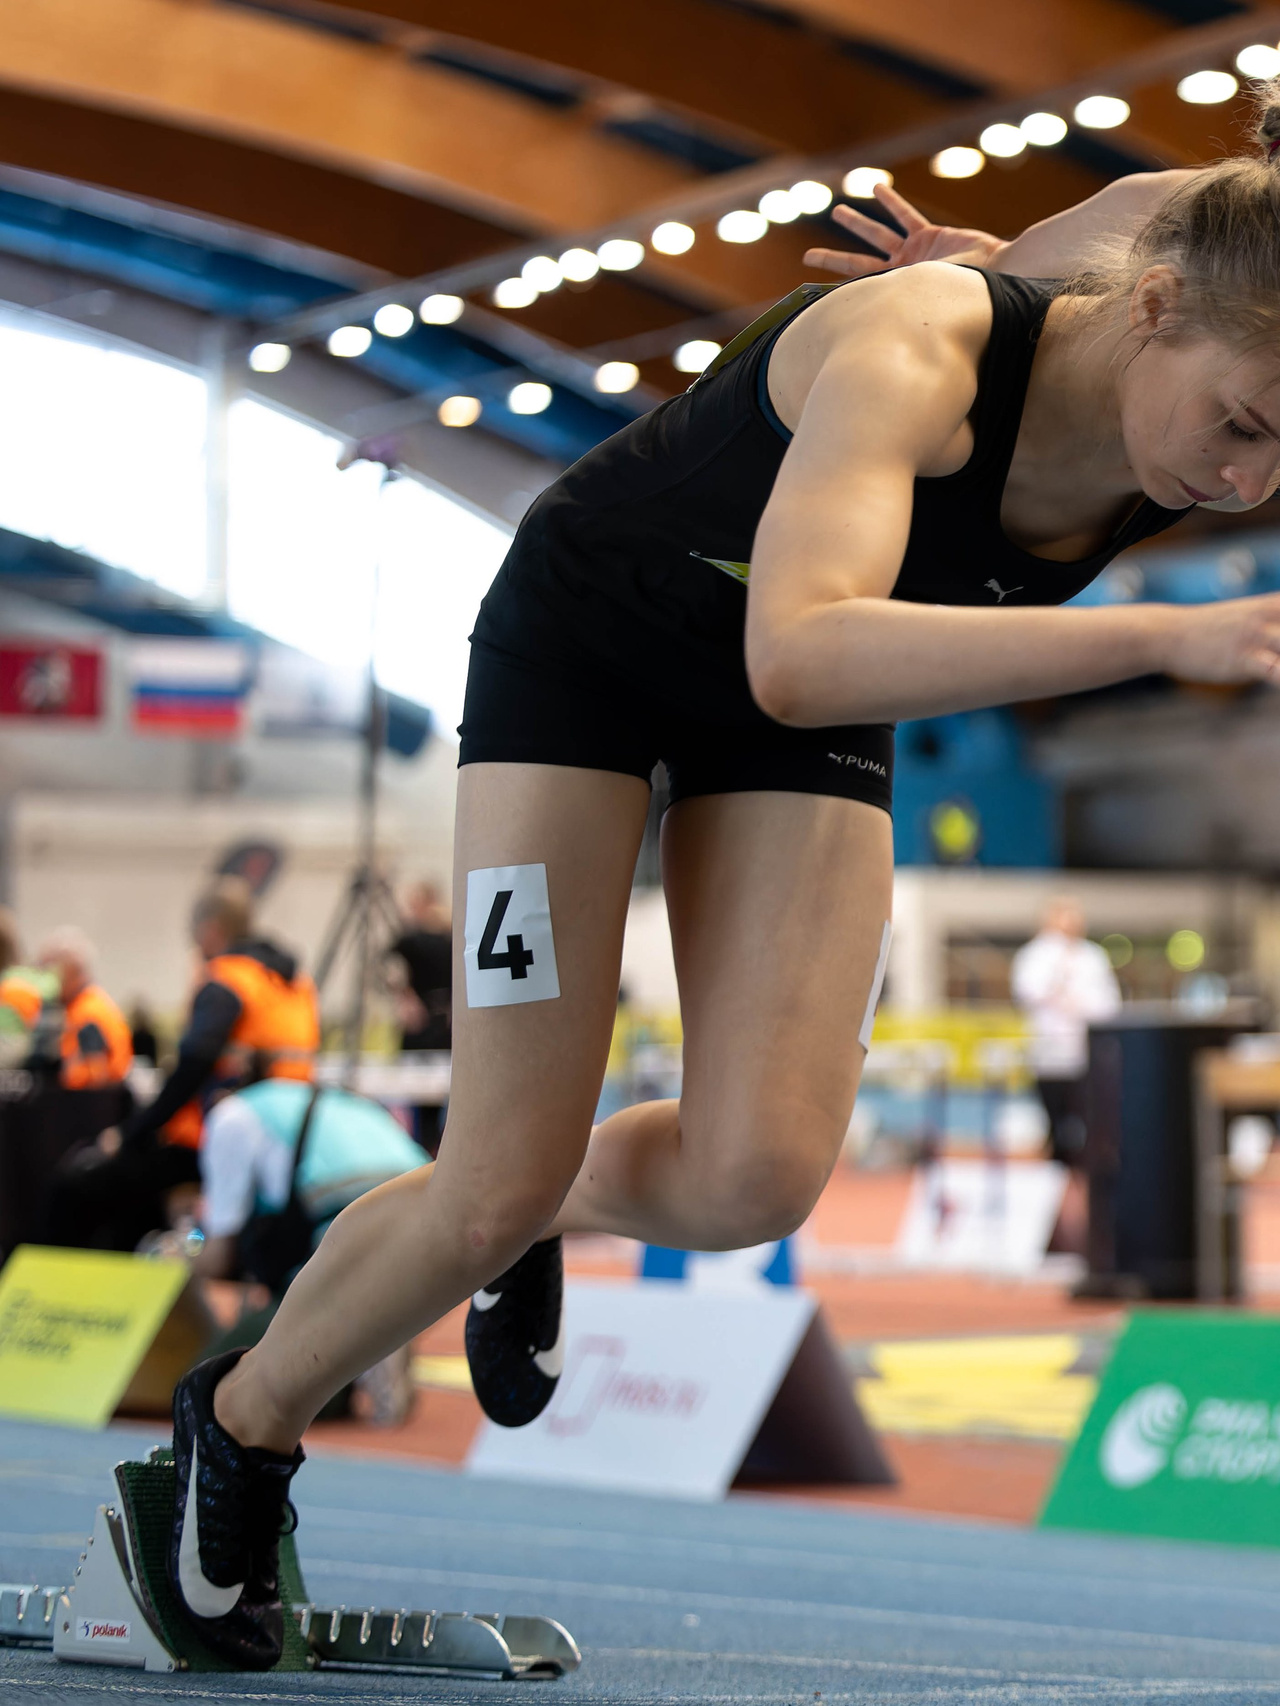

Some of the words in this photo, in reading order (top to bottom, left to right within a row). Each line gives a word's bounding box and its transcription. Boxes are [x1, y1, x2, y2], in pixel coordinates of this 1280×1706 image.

[846, 755, 887, 778] PUMA
[477, 890, 534, 980] 4
[91, 1623, 127, 1638] polanik
